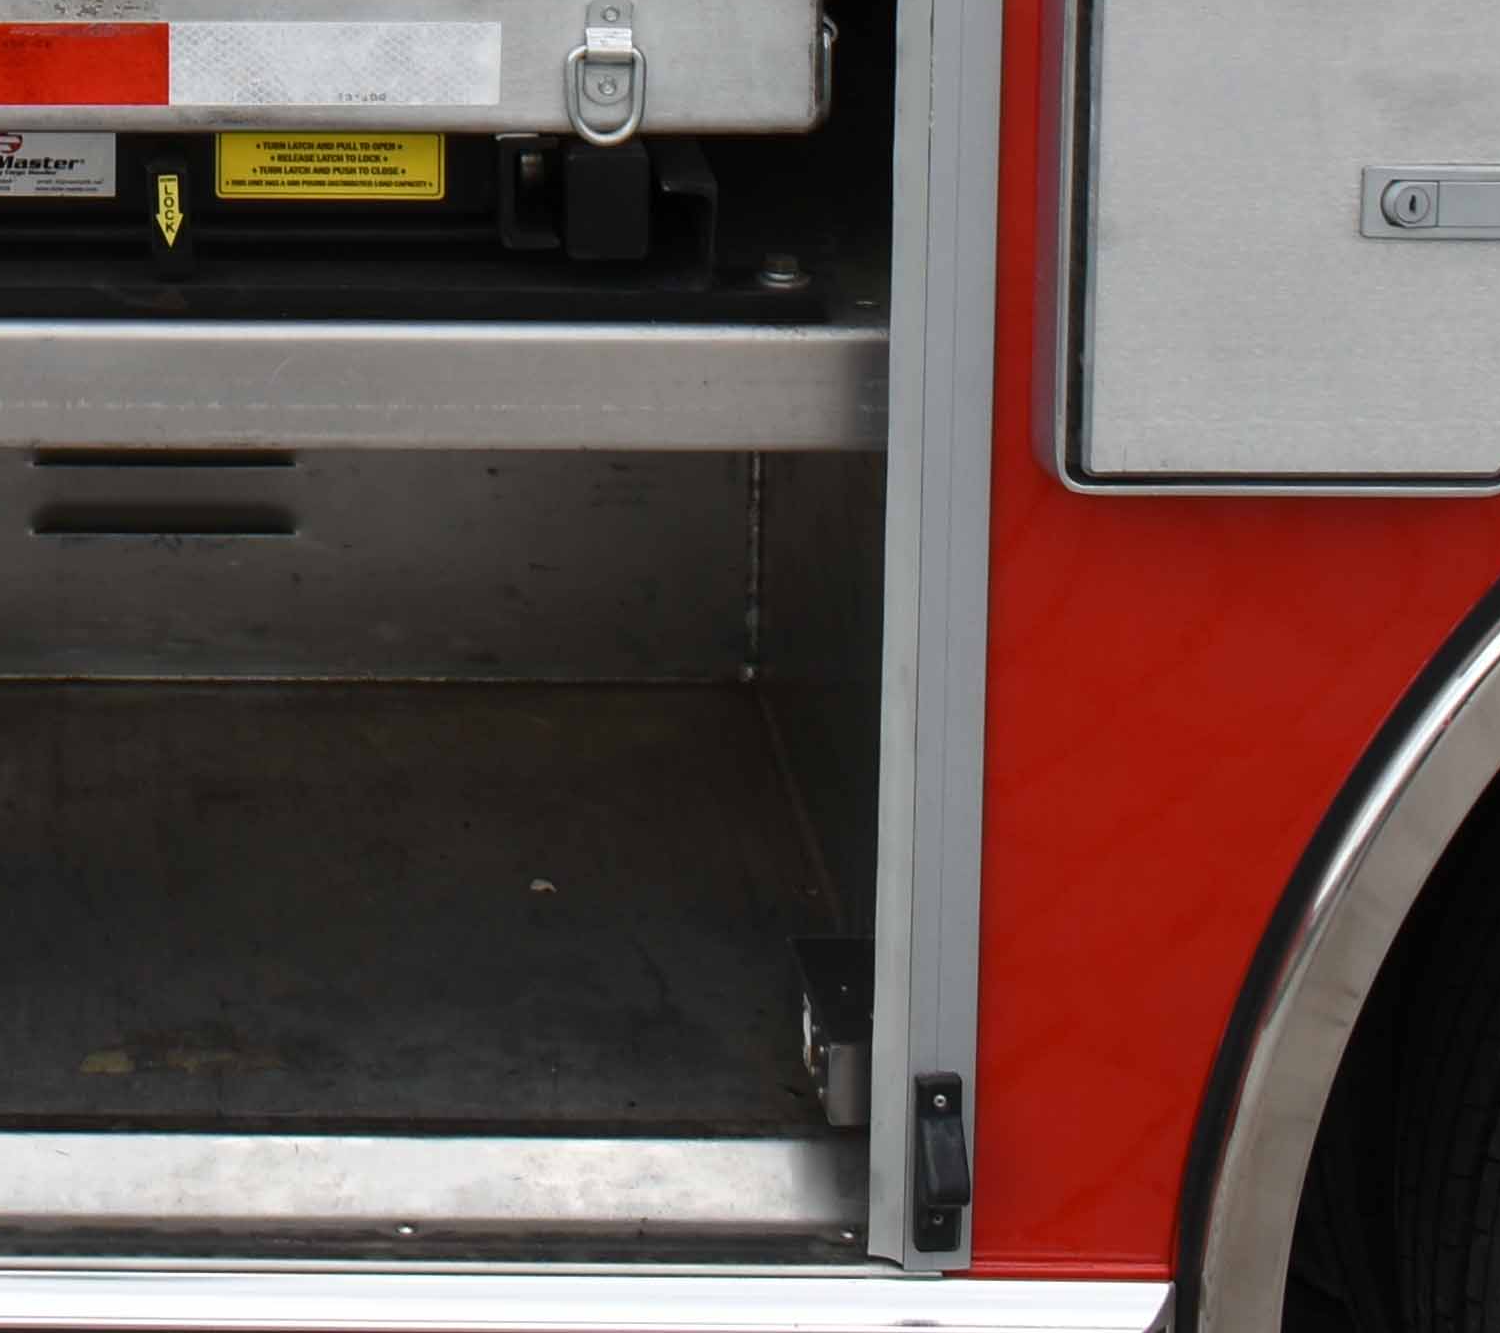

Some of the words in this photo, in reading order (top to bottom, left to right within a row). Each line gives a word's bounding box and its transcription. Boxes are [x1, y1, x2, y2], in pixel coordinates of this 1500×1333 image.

[263, 141, 286, 149] TURN
[288, 141, 314, 149] LATCH
[317, 141, 334, 149] AND
[336, 142, 357, 150] PULL
[359, 142, 370, 150] TO
[372, 142, 396, 150] OPEN
[259, 166, 283, 174] TURN
[284, 166, 310, 174] LATCH
[313, 166, 330, 174] AND
[332, 166, 356, 174] PUSH
[358, 166, 369, 174] TO
[371, 166, 399, 175] CLOSE
[164, 183, 175, 233] LOCK
